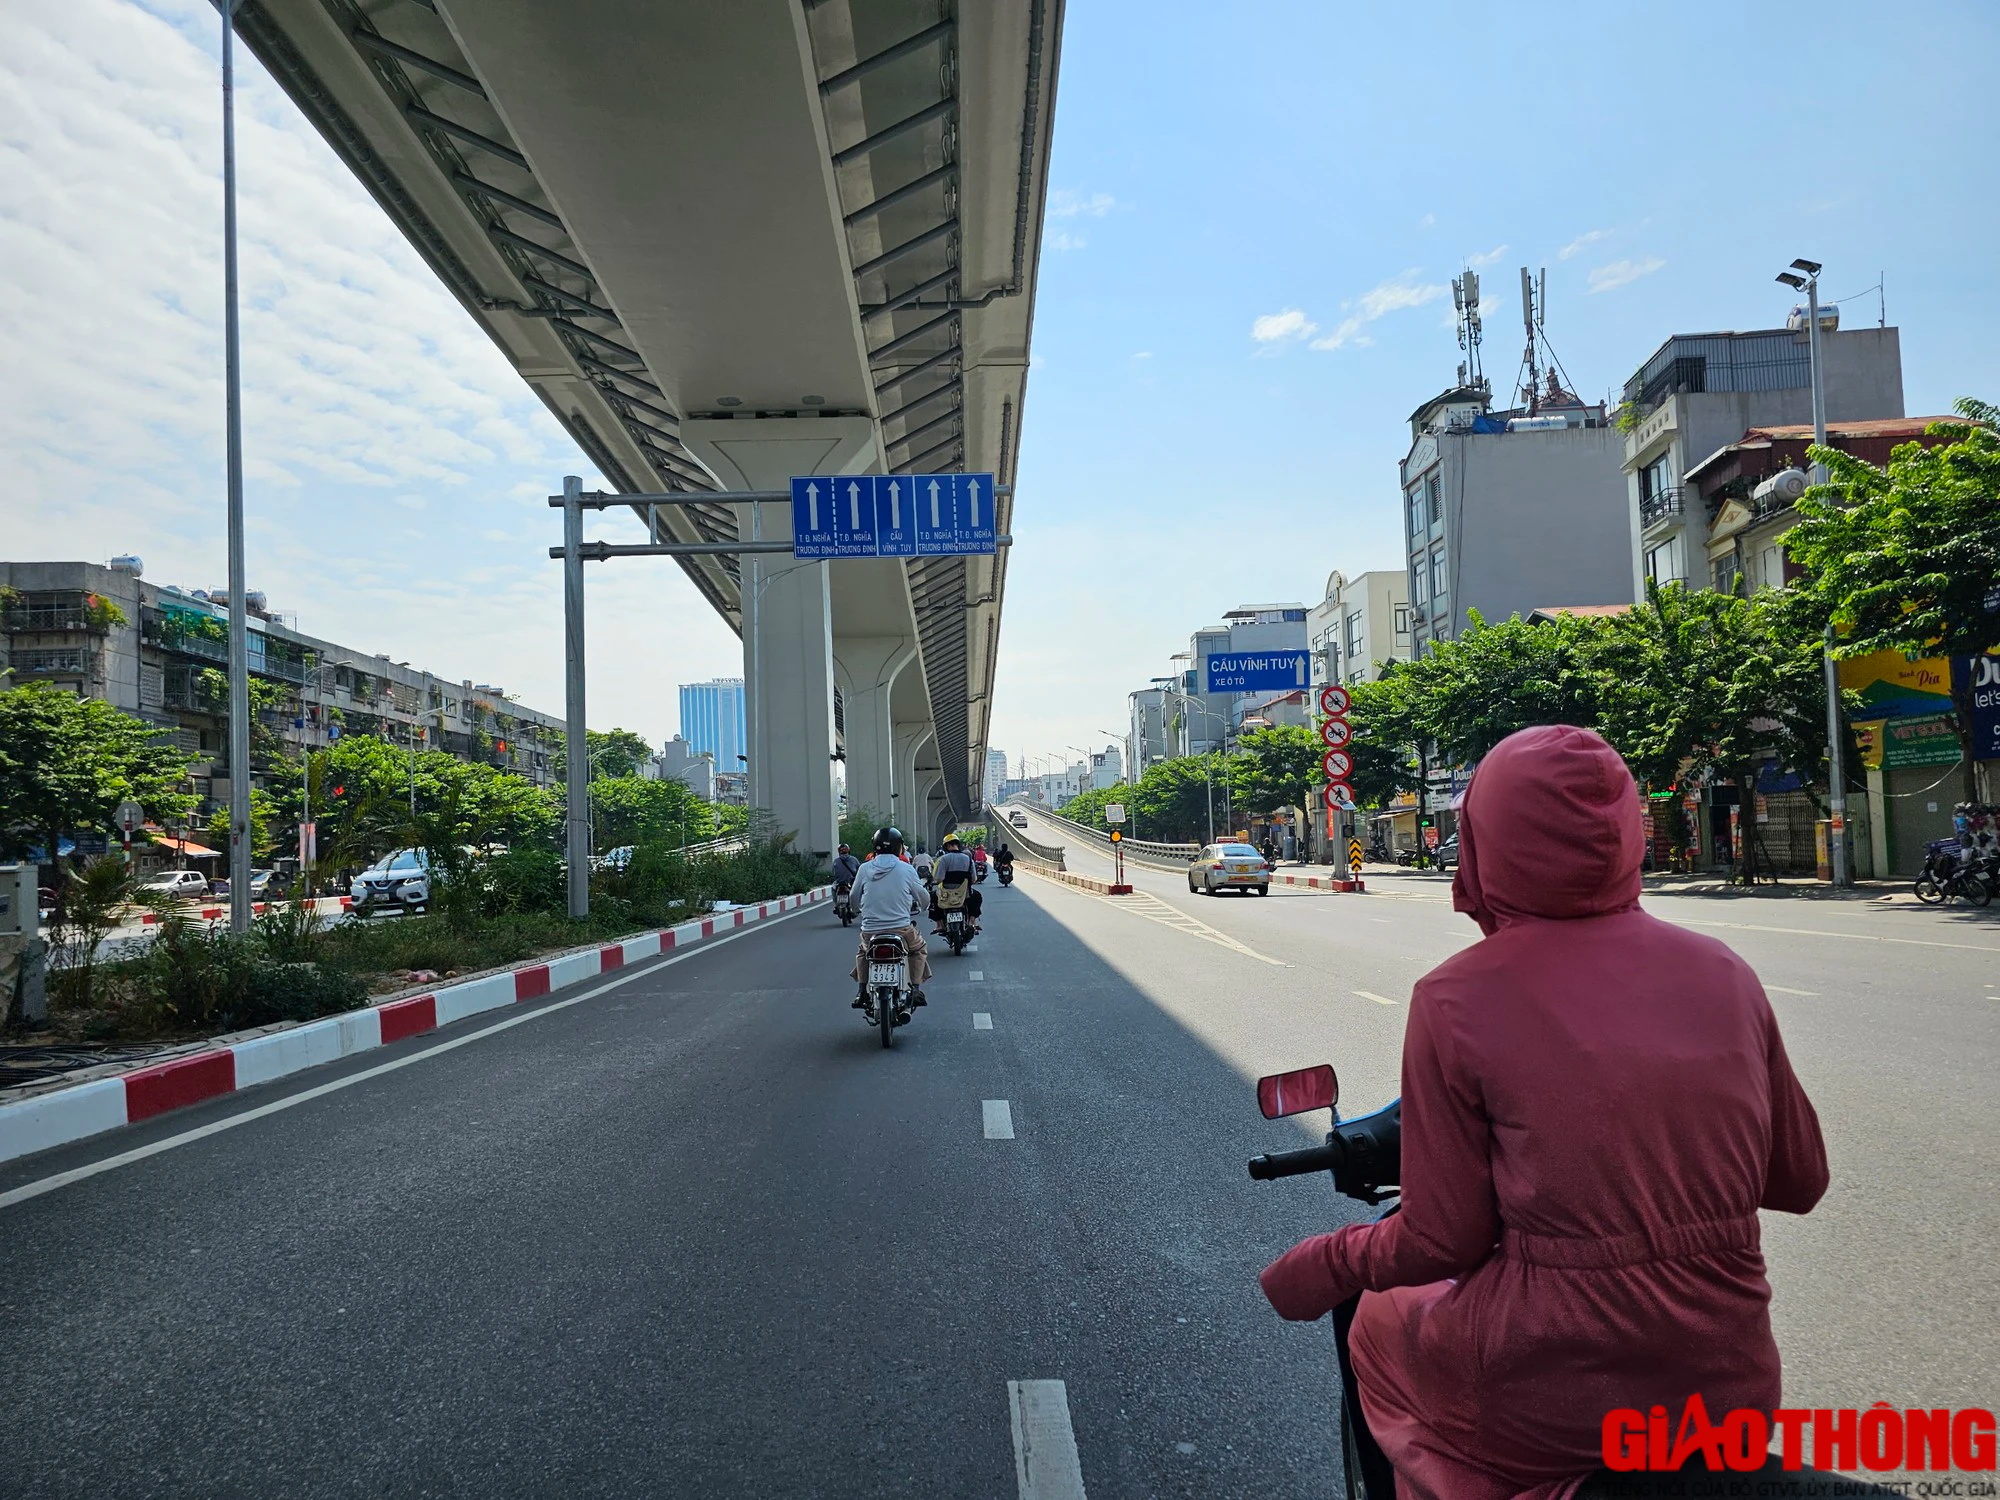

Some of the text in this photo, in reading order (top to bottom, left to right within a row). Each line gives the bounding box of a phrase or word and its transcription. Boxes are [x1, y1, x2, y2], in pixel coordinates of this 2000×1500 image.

[812, 532, 831, 543] NGHĨA
[853, 531, 872, 542] NGHĨA
[934, 529, 952, 540] NGHĨA
[973, 529, 992, 539] NGHĨA
[882, 542, 912, 552] VĨNH TUY
[1211, 657, 1295, 672] CẦU VĨNH TUY
[1215, 675, 1245, 686] XE Ô TÔ
